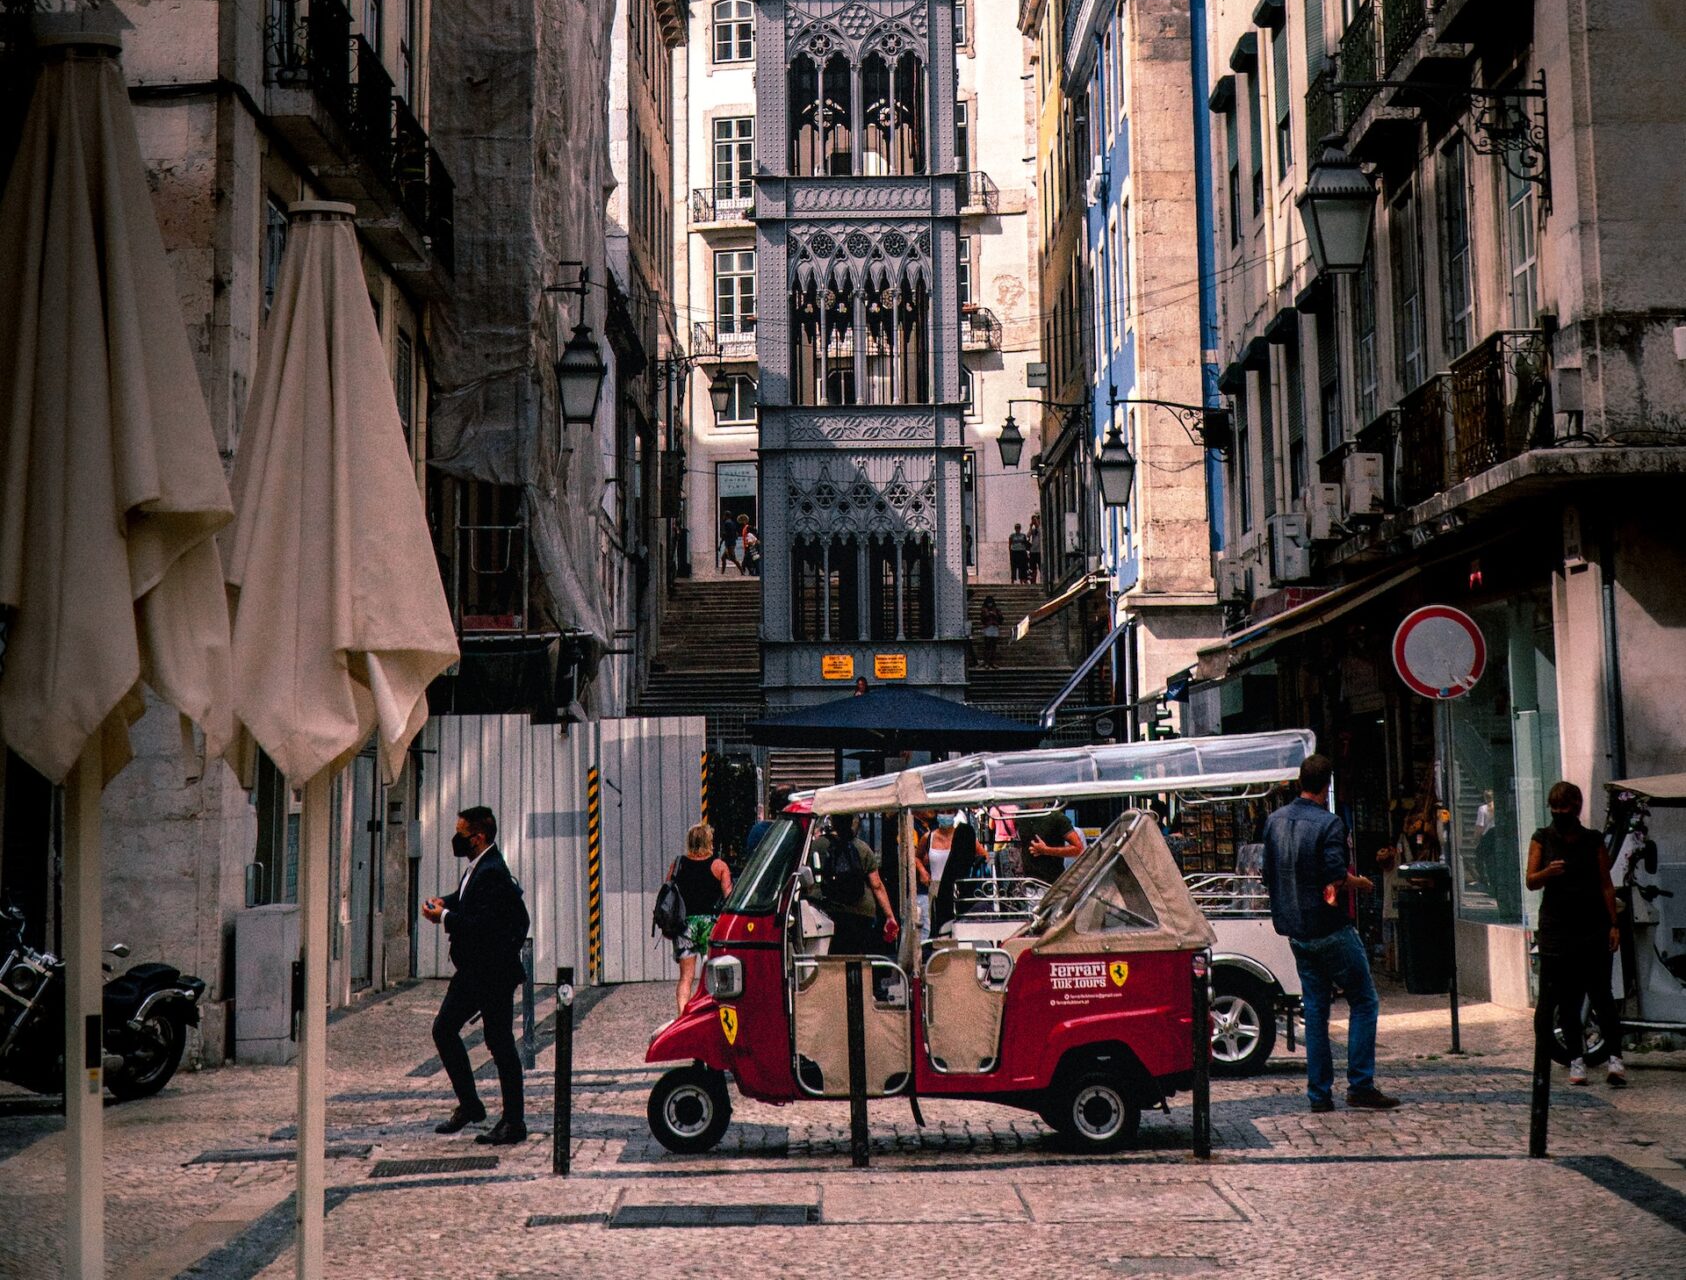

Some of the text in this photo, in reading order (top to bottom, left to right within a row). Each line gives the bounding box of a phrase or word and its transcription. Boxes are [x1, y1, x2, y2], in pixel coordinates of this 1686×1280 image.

[1050, 962, 1106, 977] Ferrari
[1051, 977, 1106, 989] Tuk Tours
